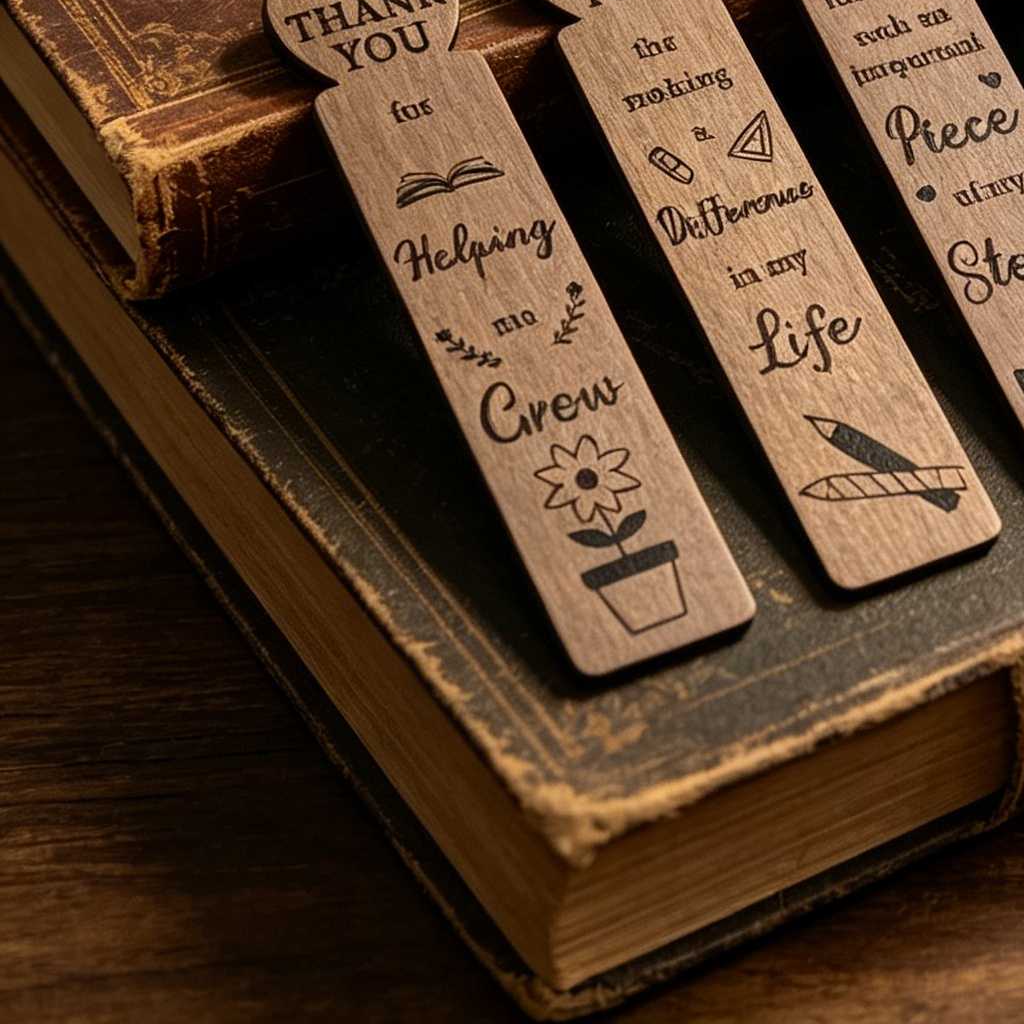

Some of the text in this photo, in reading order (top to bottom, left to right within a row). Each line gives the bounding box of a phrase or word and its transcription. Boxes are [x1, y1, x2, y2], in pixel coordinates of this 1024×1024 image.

[334, 20, 431, 73] YOU
[885, 104, 1020, 166] Piece
[394, 218, 556, 281] Helping
[729, 265, 762, 290] in
[749, 303, 862, 375] Life
